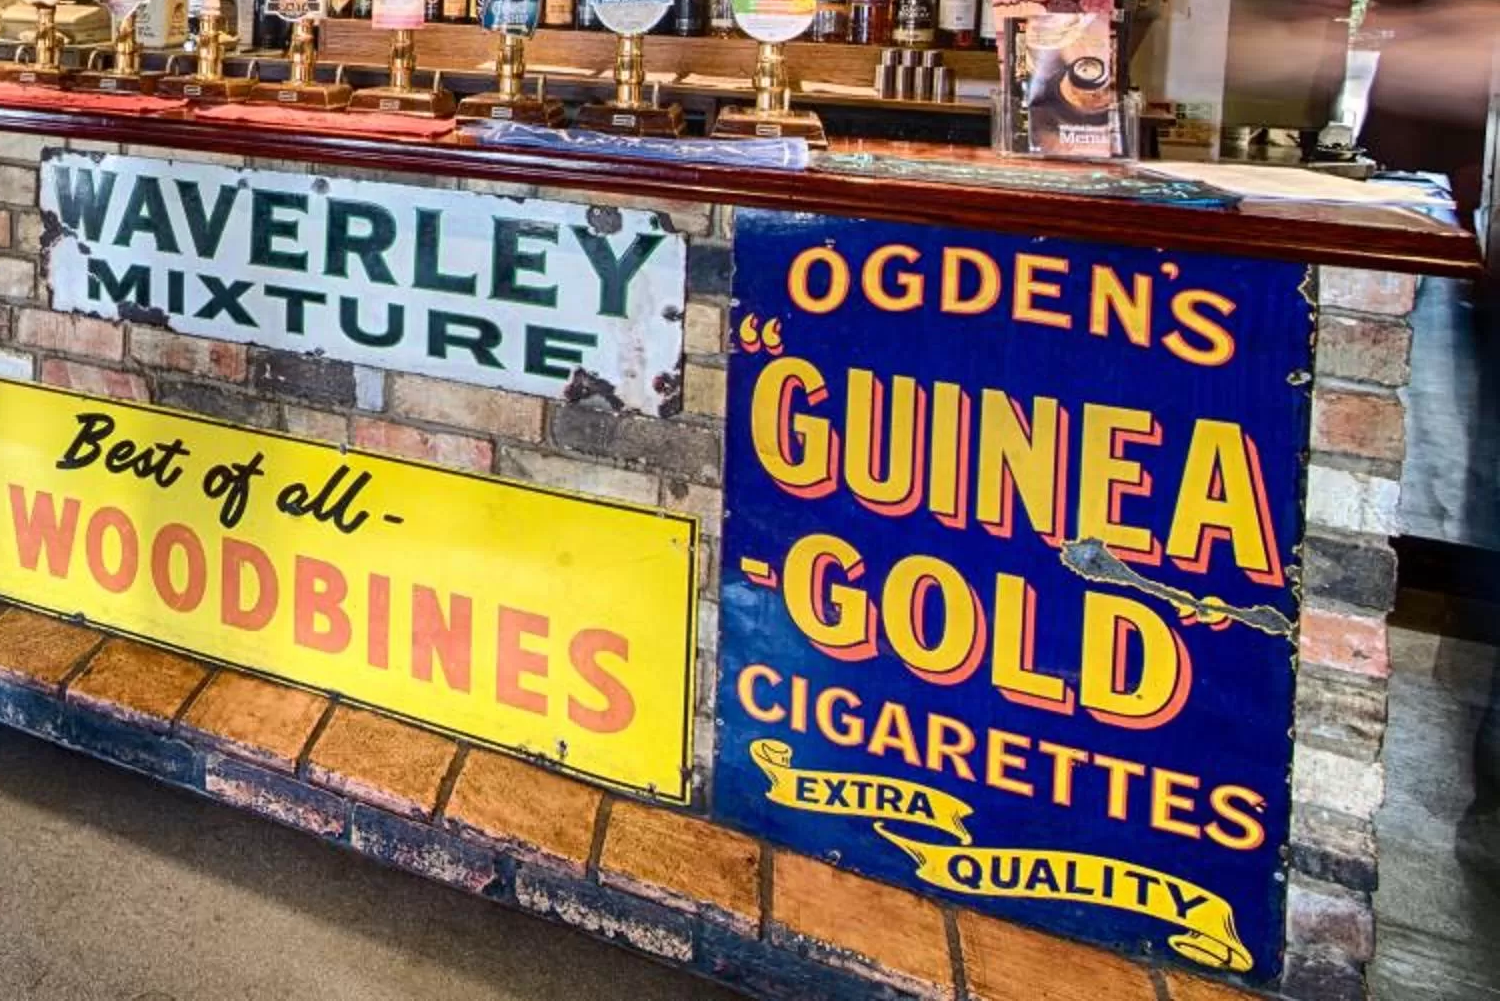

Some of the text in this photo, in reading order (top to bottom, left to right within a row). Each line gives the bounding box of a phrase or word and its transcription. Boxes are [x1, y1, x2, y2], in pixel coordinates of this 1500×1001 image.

[53, 165, 665, 320] WAVERLEY
[86, 258, 599, 381] MIXTURE
[788, 243, 1238, 369] OGDEN'S
[56, 412, 269, 529] Best of
[8, 482, 638, 734] WOODBINES
[736, 663, 1268, 851] CIGARETTES
[794, 775, 937, 821] EXTRA
[946, 851, 1216, 920] QUALITY
